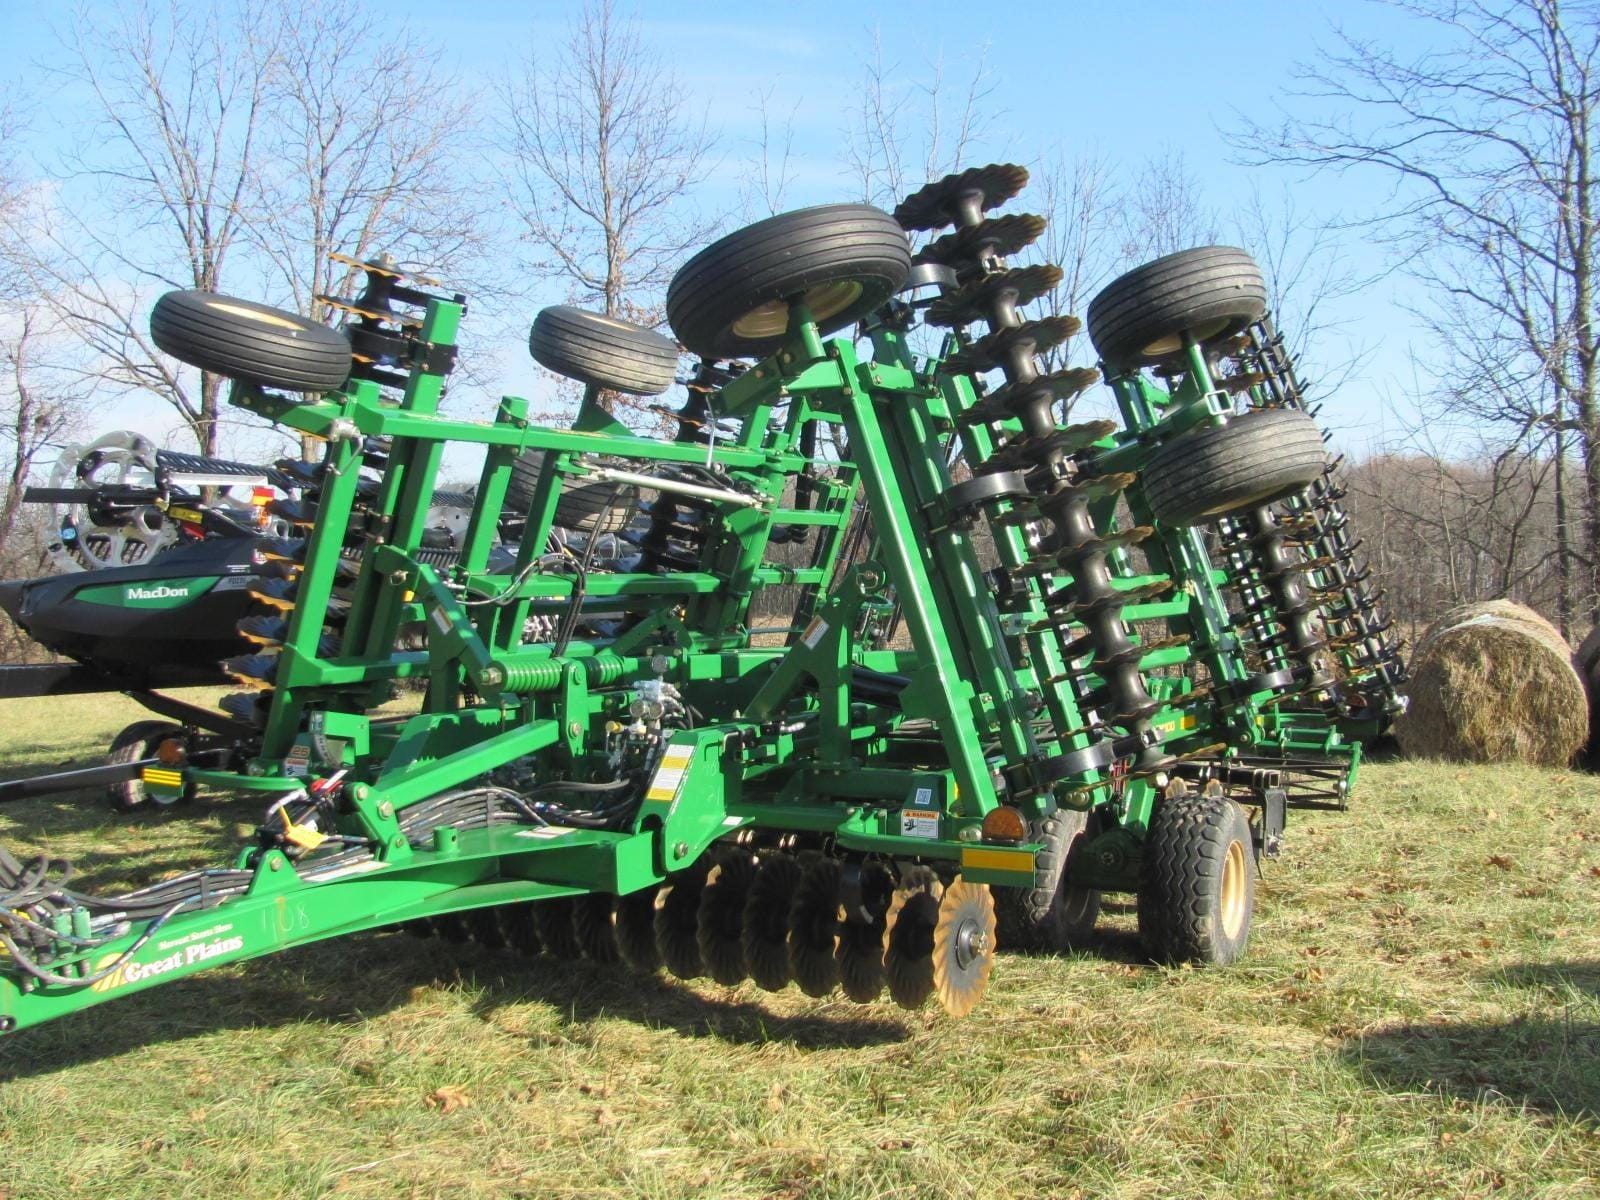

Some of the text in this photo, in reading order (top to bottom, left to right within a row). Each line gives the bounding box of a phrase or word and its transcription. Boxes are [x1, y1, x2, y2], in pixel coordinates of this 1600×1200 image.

[127, 586, 189, 600] MacDon
[125, 936, 243, 982] Great Plains
